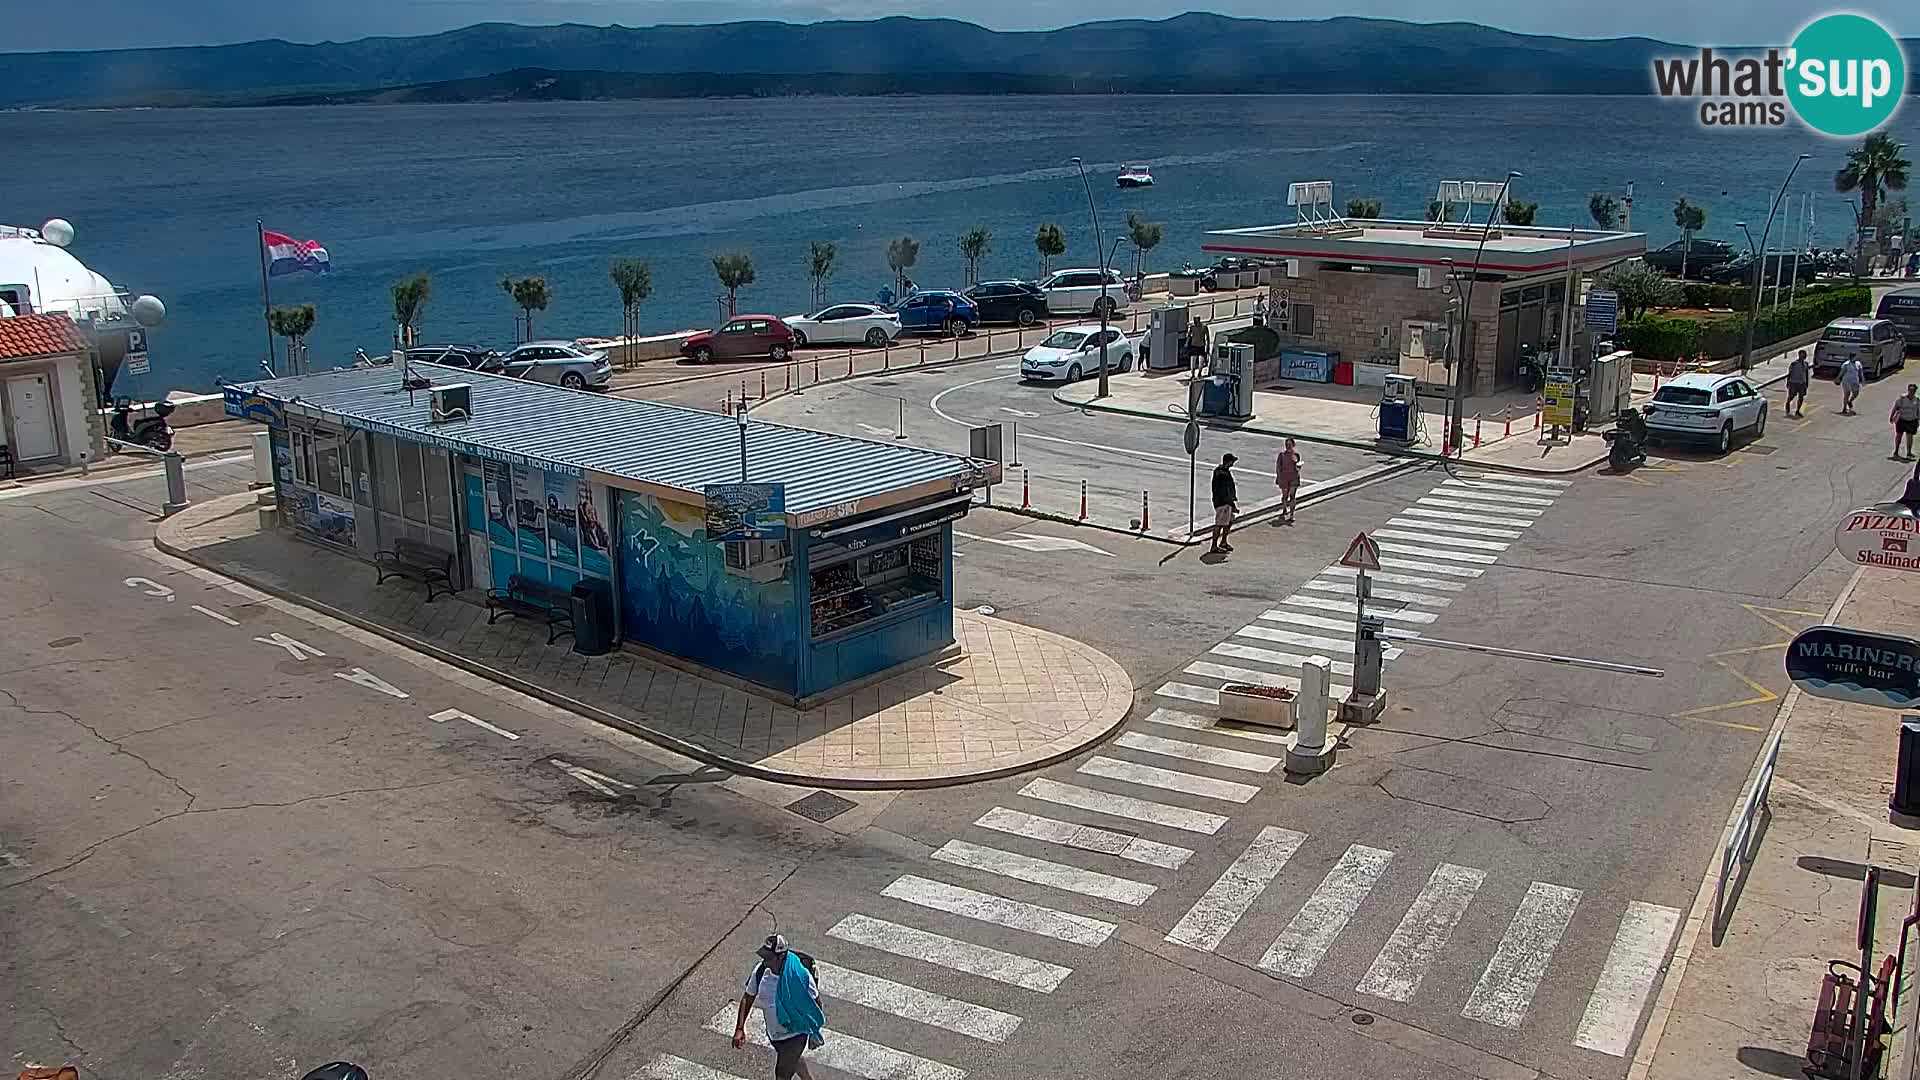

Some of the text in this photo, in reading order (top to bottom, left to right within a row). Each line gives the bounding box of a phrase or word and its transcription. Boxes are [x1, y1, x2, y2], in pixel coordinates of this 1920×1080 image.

[129, 332, 141, 350] P
[435, 438, 467, 453] POSTAJA
[477, 447, 492, 458] BUS
[492, 451, 525, 465] STATION
[527, 457, 553, 471] TICKET
[554, 464, 581, 477] OFFICE
[1879, 530, 1913, 541] GRILL
[1857, 550, 1920, 569] Skalinad
[1868, 665, 1895, 680] bar
